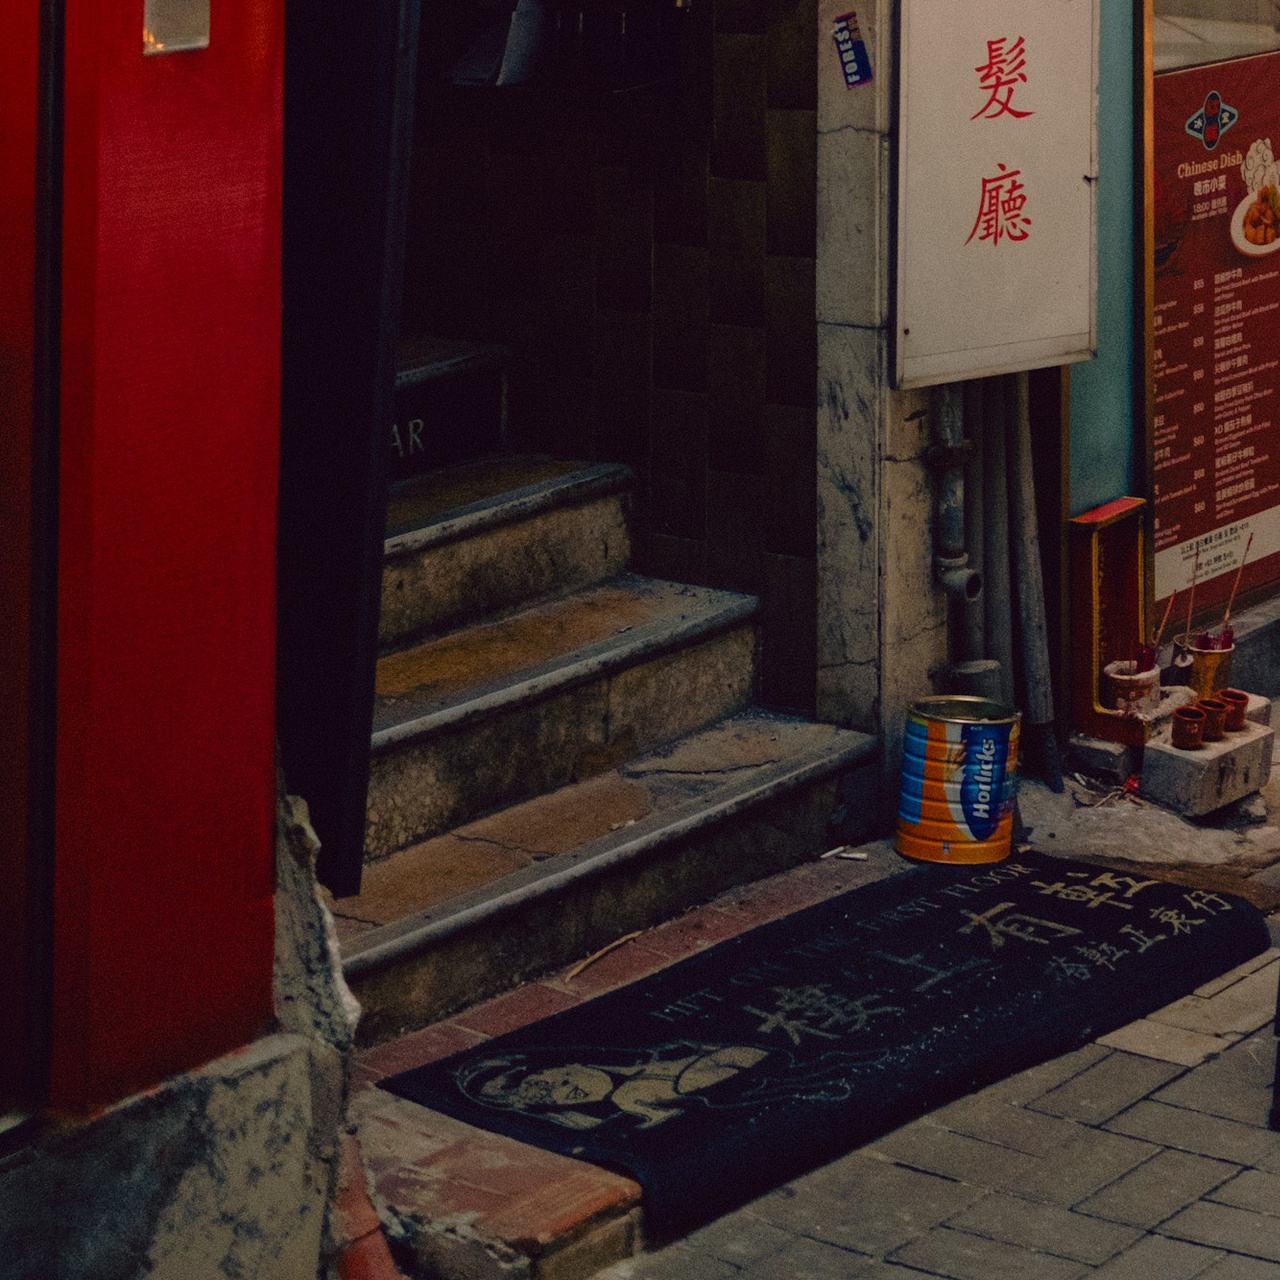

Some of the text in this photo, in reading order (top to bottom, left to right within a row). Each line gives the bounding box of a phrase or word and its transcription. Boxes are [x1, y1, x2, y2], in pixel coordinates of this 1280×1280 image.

[1177, 150, 1244, 179] Chinese Dish
[972, 738, 997, 819] Horlicks
[857, 897, 943, 933] FIRST
[943, 862, 1040, 901] FLOOR
